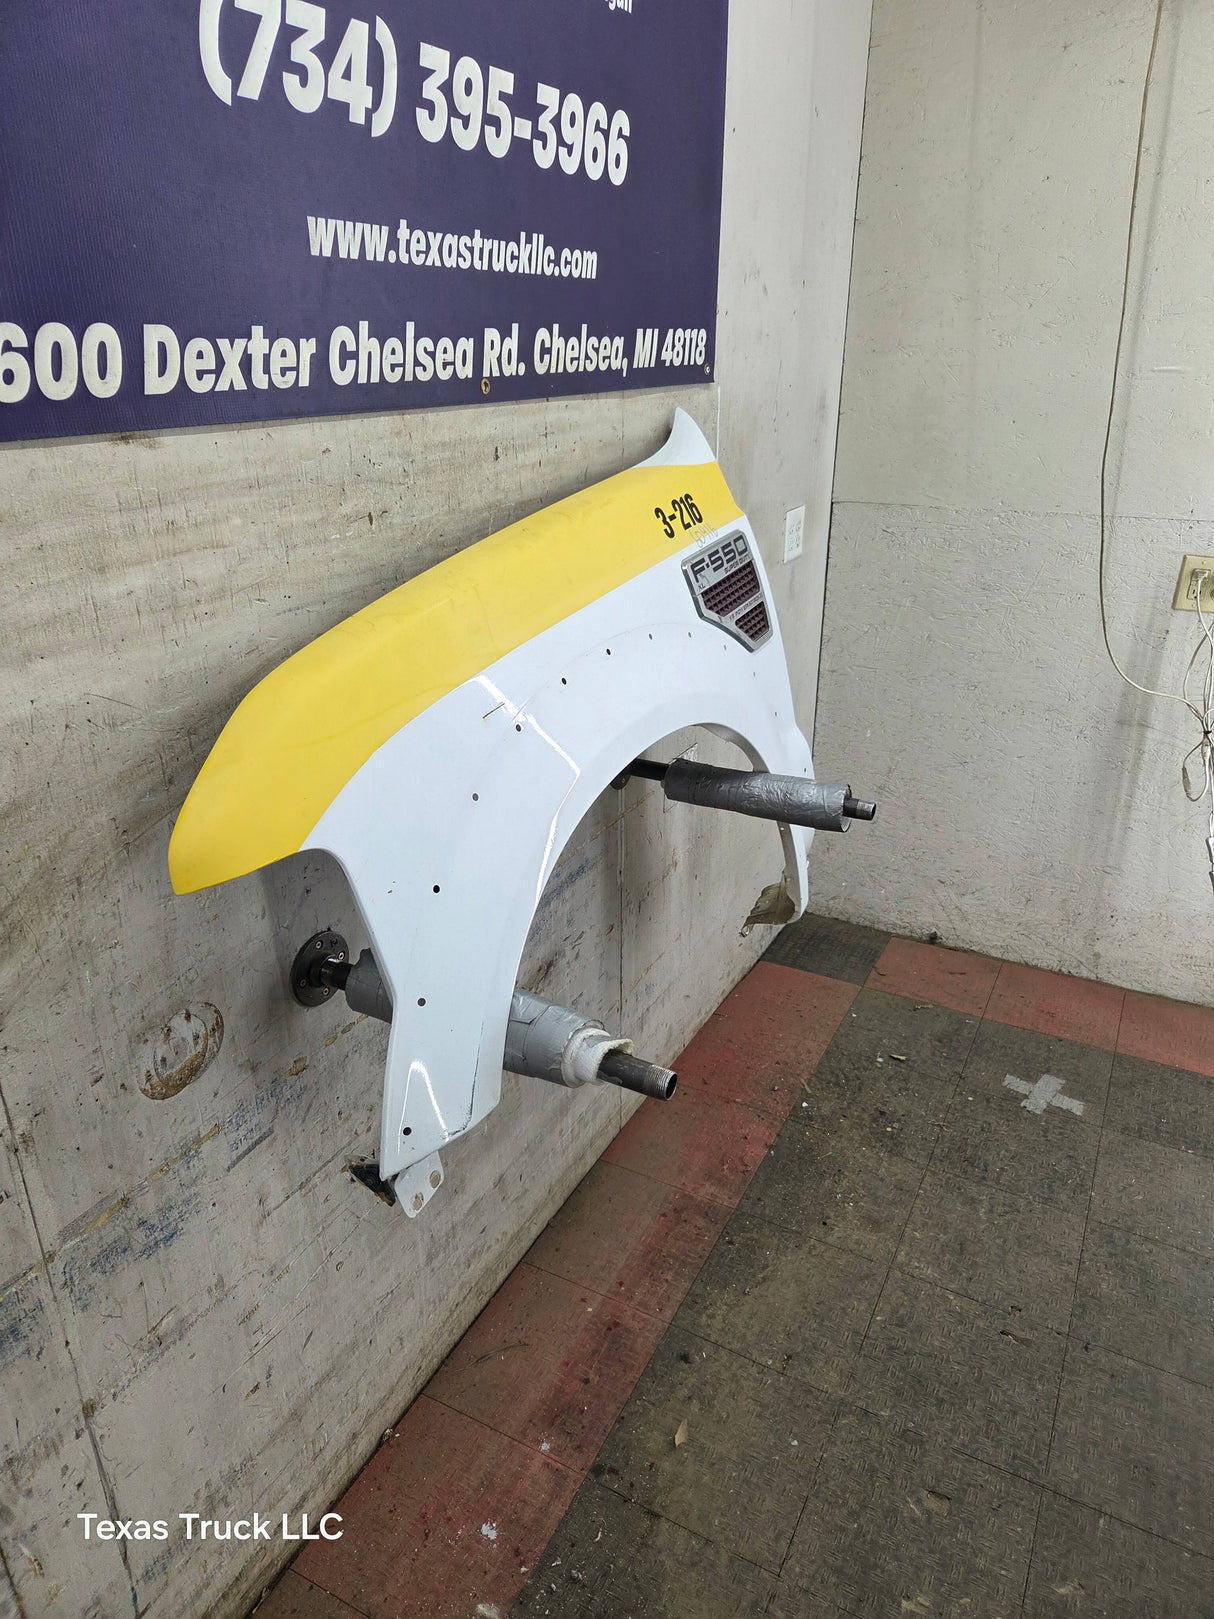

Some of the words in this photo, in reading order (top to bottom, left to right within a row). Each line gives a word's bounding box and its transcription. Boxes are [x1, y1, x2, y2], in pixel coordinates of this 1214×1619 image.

[199, 0, 398, 138] (734)
[415, 41, 631, 186] 395-3966
[306, 215, 598, 280] www.texastruckllc.com
[143, 323, 316, 396] Dexter
[329, 320, 474, 386] Chelsea
[482, 322, 526, 378] Rd.
[533, 323, 628, 378] Chelsea,
[632, 328, 659, 369] MI
[661, 327, 707, 367] 48118
[654, 493, 703, 539] 3-216
[690, 534, 748, 583] F-550
